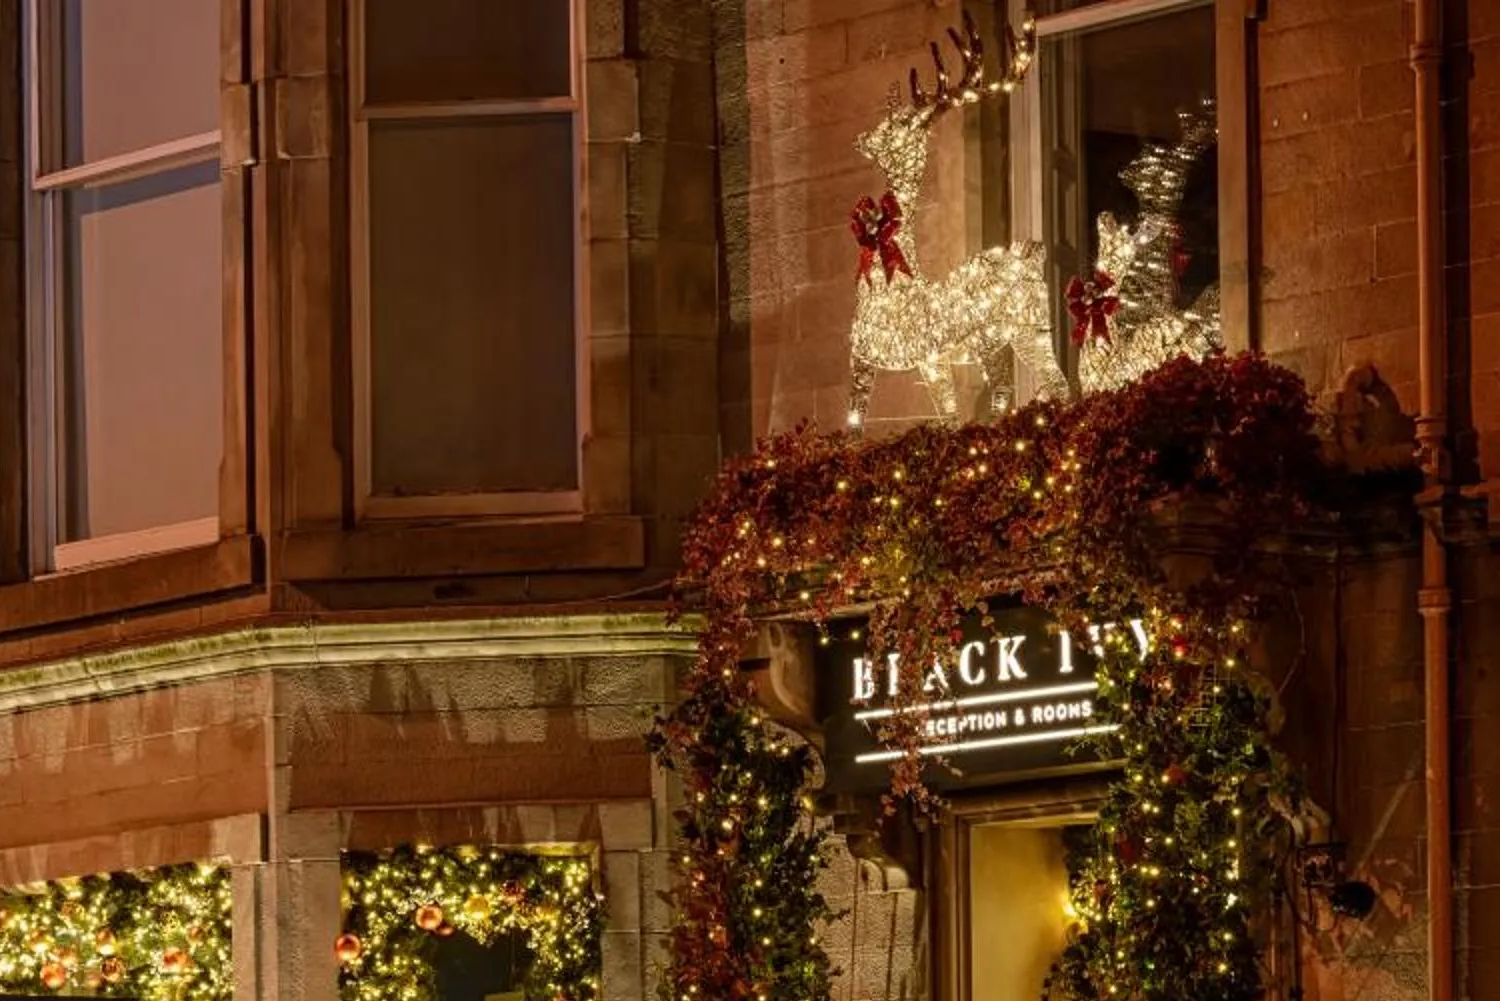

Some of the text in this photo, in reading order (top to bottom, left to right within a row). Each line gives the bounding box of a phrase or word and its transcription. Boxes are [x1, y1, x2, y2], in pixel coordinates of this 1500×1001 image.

[852, 635, 1028, 700] BLACK
[919, 700, 1093, 738] ECEPTION & ROOMS
